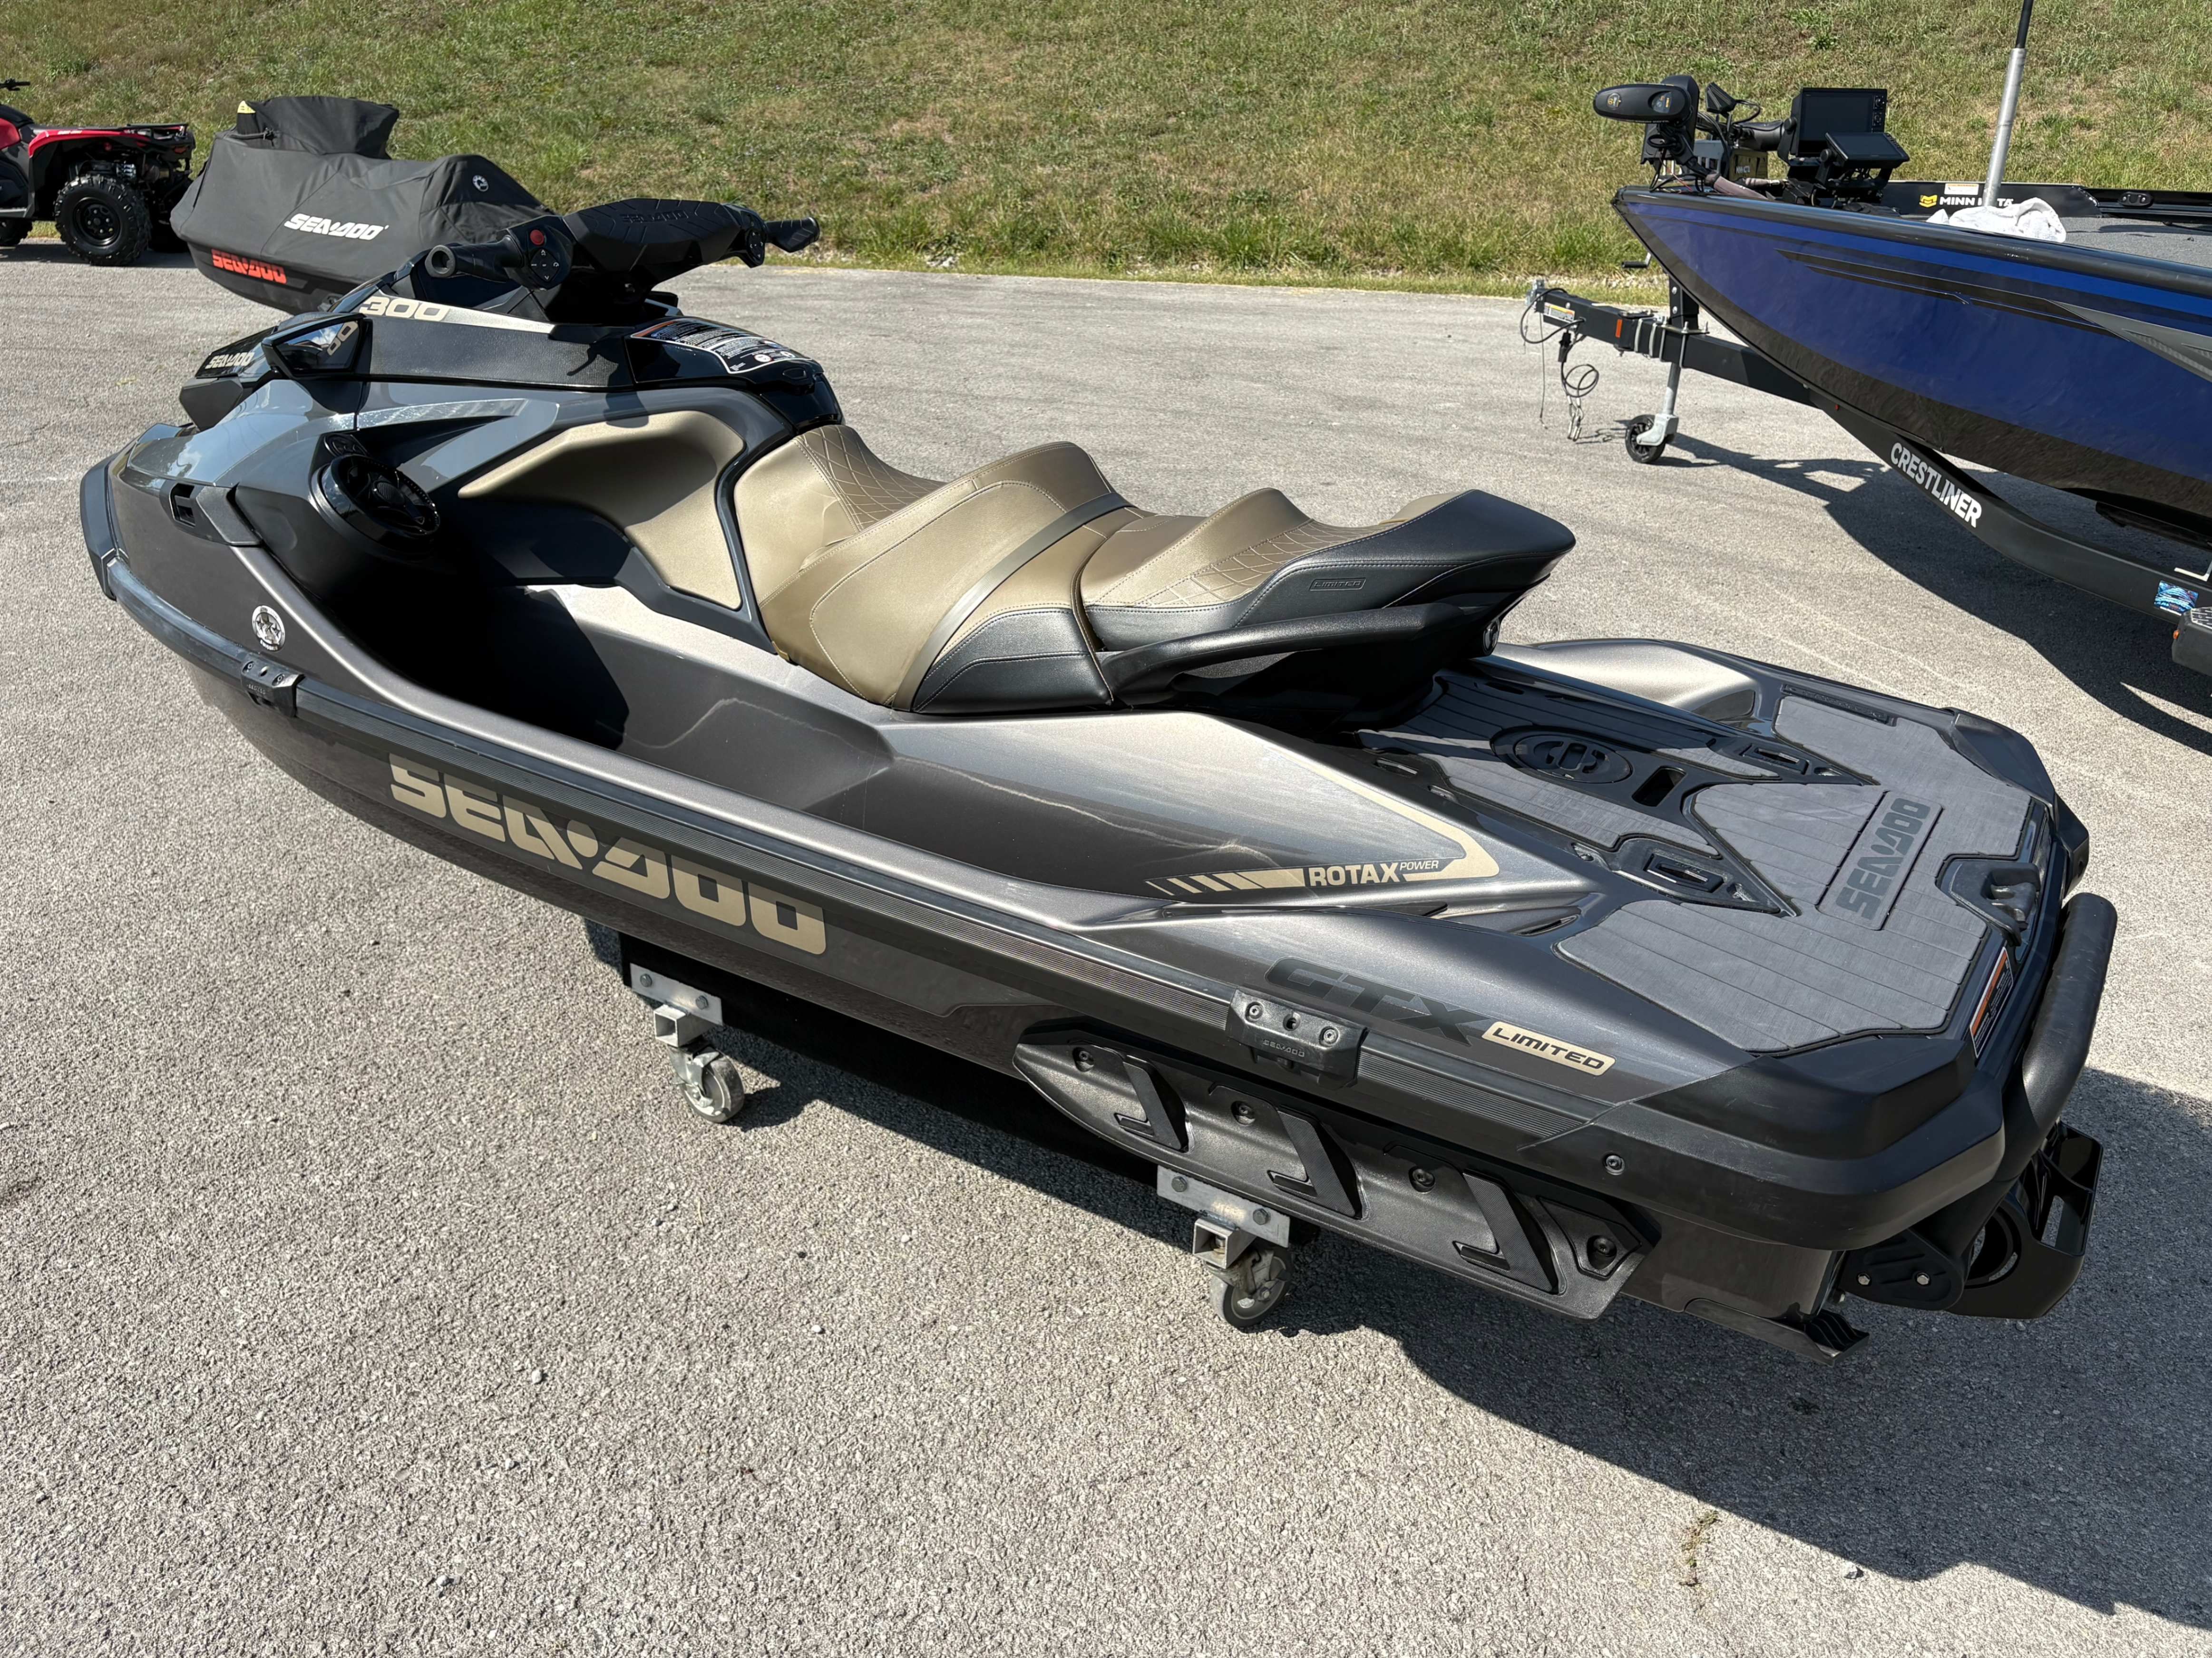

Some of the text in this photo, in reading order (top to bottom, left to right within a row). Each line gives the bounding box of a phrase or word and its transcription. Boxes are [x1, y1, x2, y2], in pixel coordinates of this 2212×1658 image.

[1939, 196, 1975, 206] MINN
[359, 296, 448, 322] 300
[1891, 442, 1982, 528] CRESTLINER
[1309, 860, 1439, 887] ROTAX POWER
[1265, 957, 1492, 1047] GTX
[1492, 1027, 1605, 1070] LIMITED
